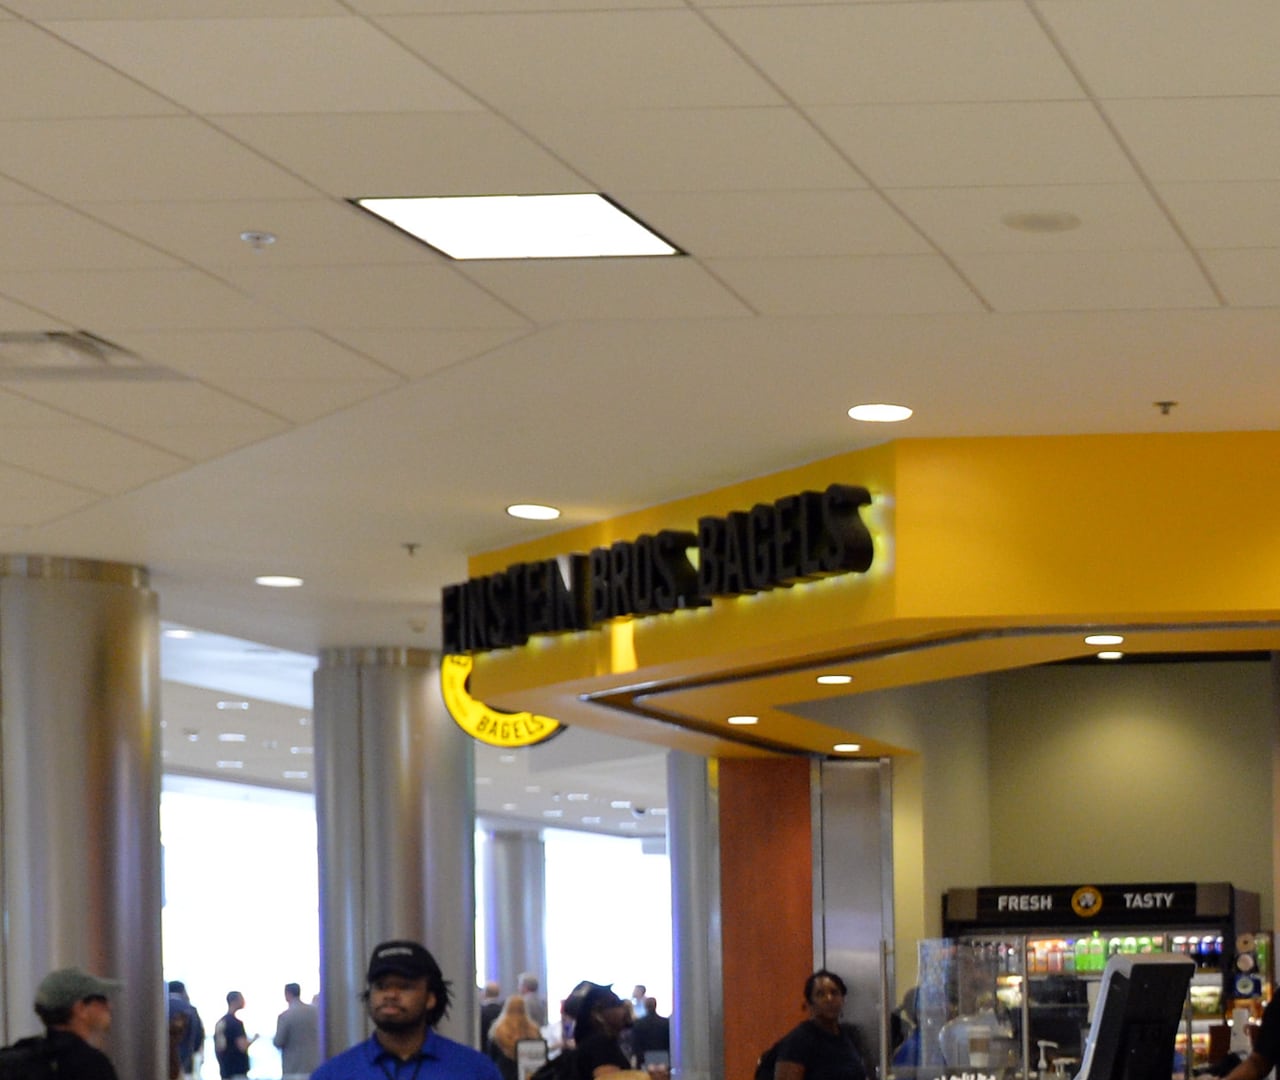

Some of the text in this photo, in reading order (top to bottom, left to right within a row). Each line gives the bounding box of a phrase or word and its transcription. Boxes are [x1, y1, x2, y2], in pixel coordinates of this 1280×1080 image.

[698, 484, 872, 600] BAGELS
[476, 715, 546, 739] BAGELS
[998, 895, 1053, 911] FRESH
[1123, 892, 1175, 909] TASTY
